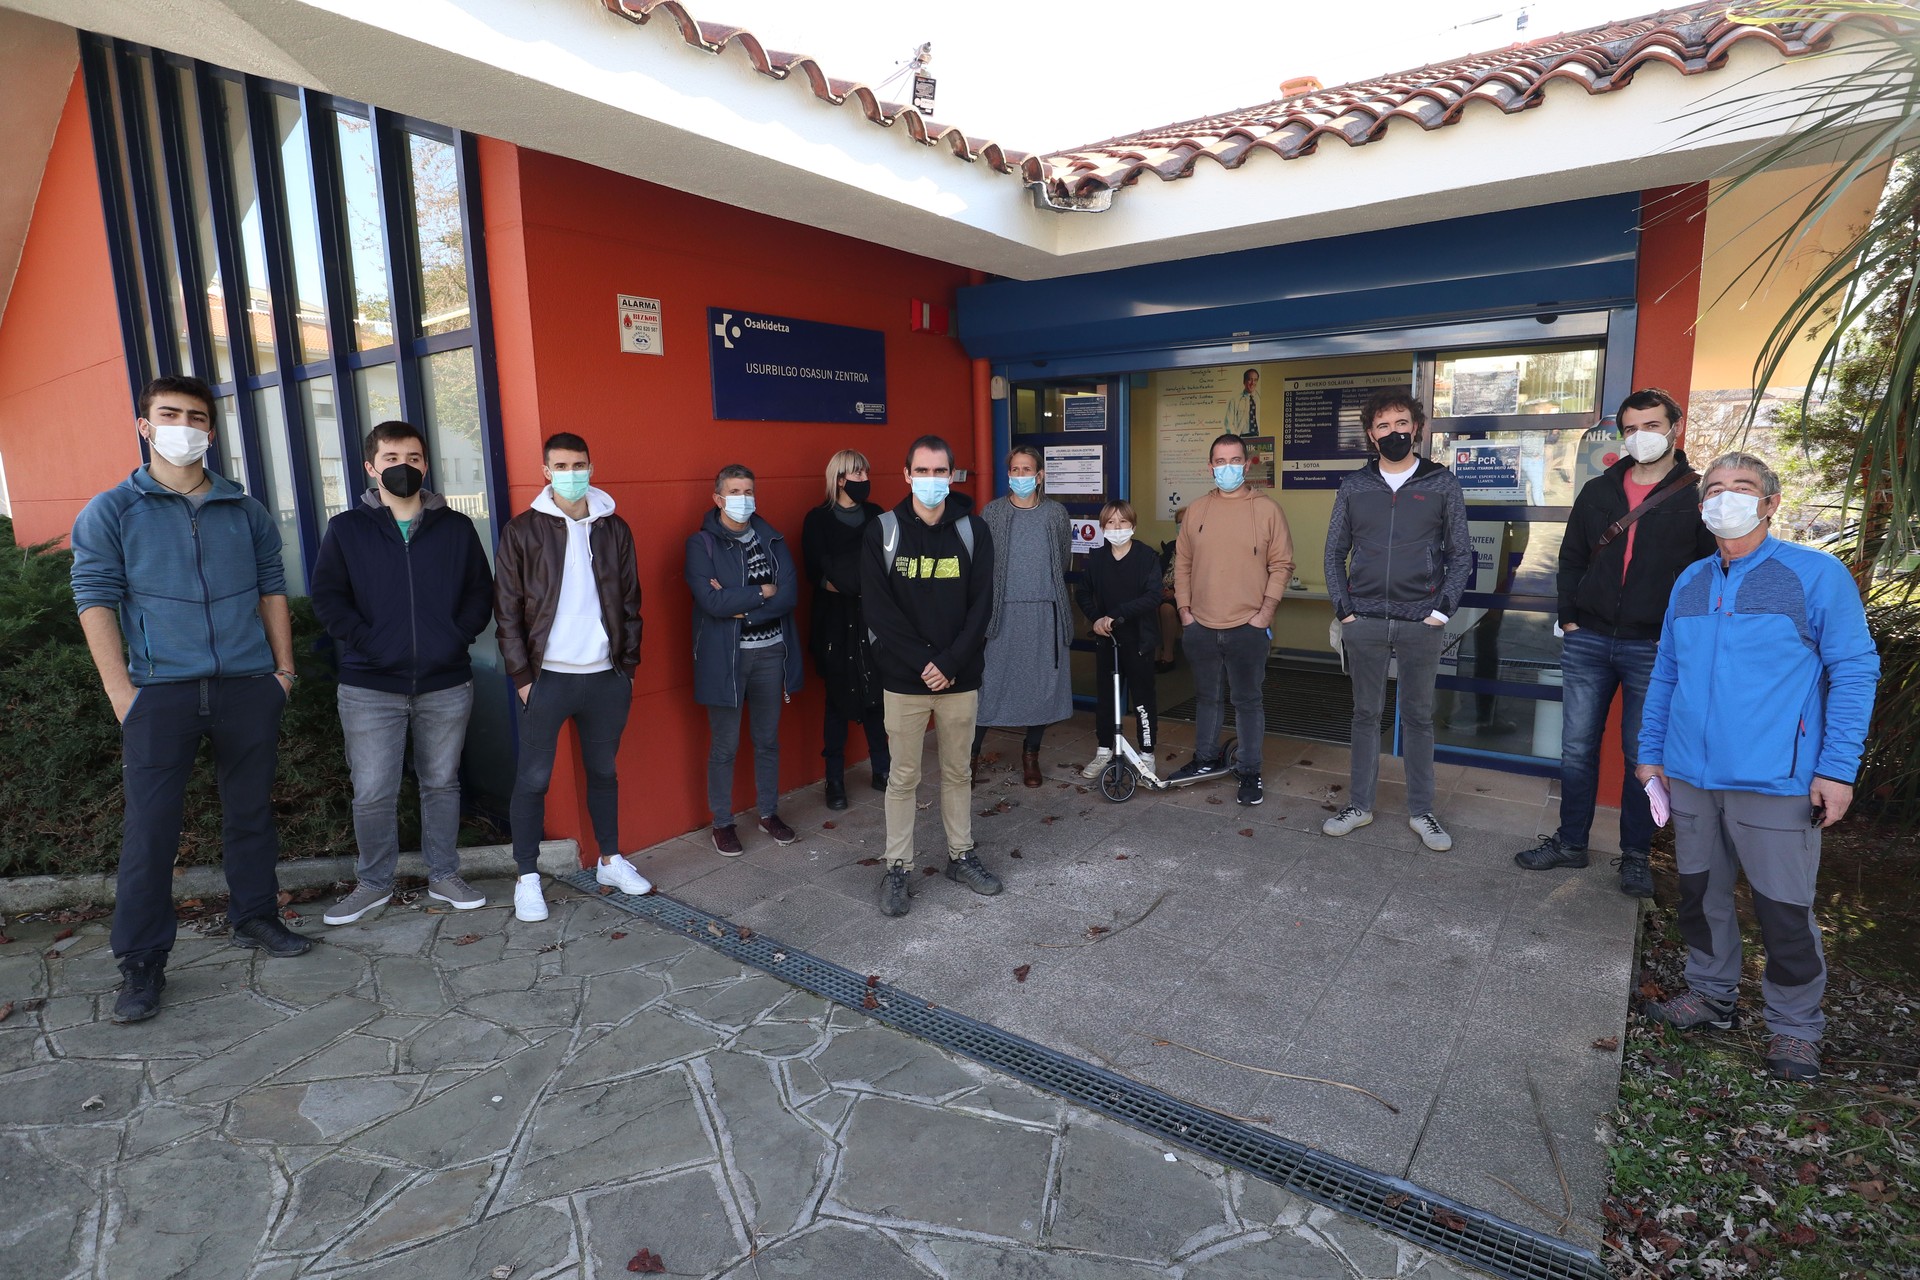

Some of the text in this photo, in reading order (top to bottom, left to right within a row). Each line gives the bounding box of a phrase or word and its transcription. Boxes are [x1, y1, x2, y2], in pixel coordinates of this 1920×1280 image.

[622, 299, 657, 310] ALARMA
[632, 313, 658, 322] BIZKOR
[744, 317, 790, 333] Osakidetza
[745, 362, 869, 383] USURBILGO OSASUN ZENTROA
[1293, 381, 1299, 389] 0
[1477, 456, 1496, 465] PCR
[1469, 535, 1495, 544] ENTEEN
[1477, 553, 1493, 561] URA
